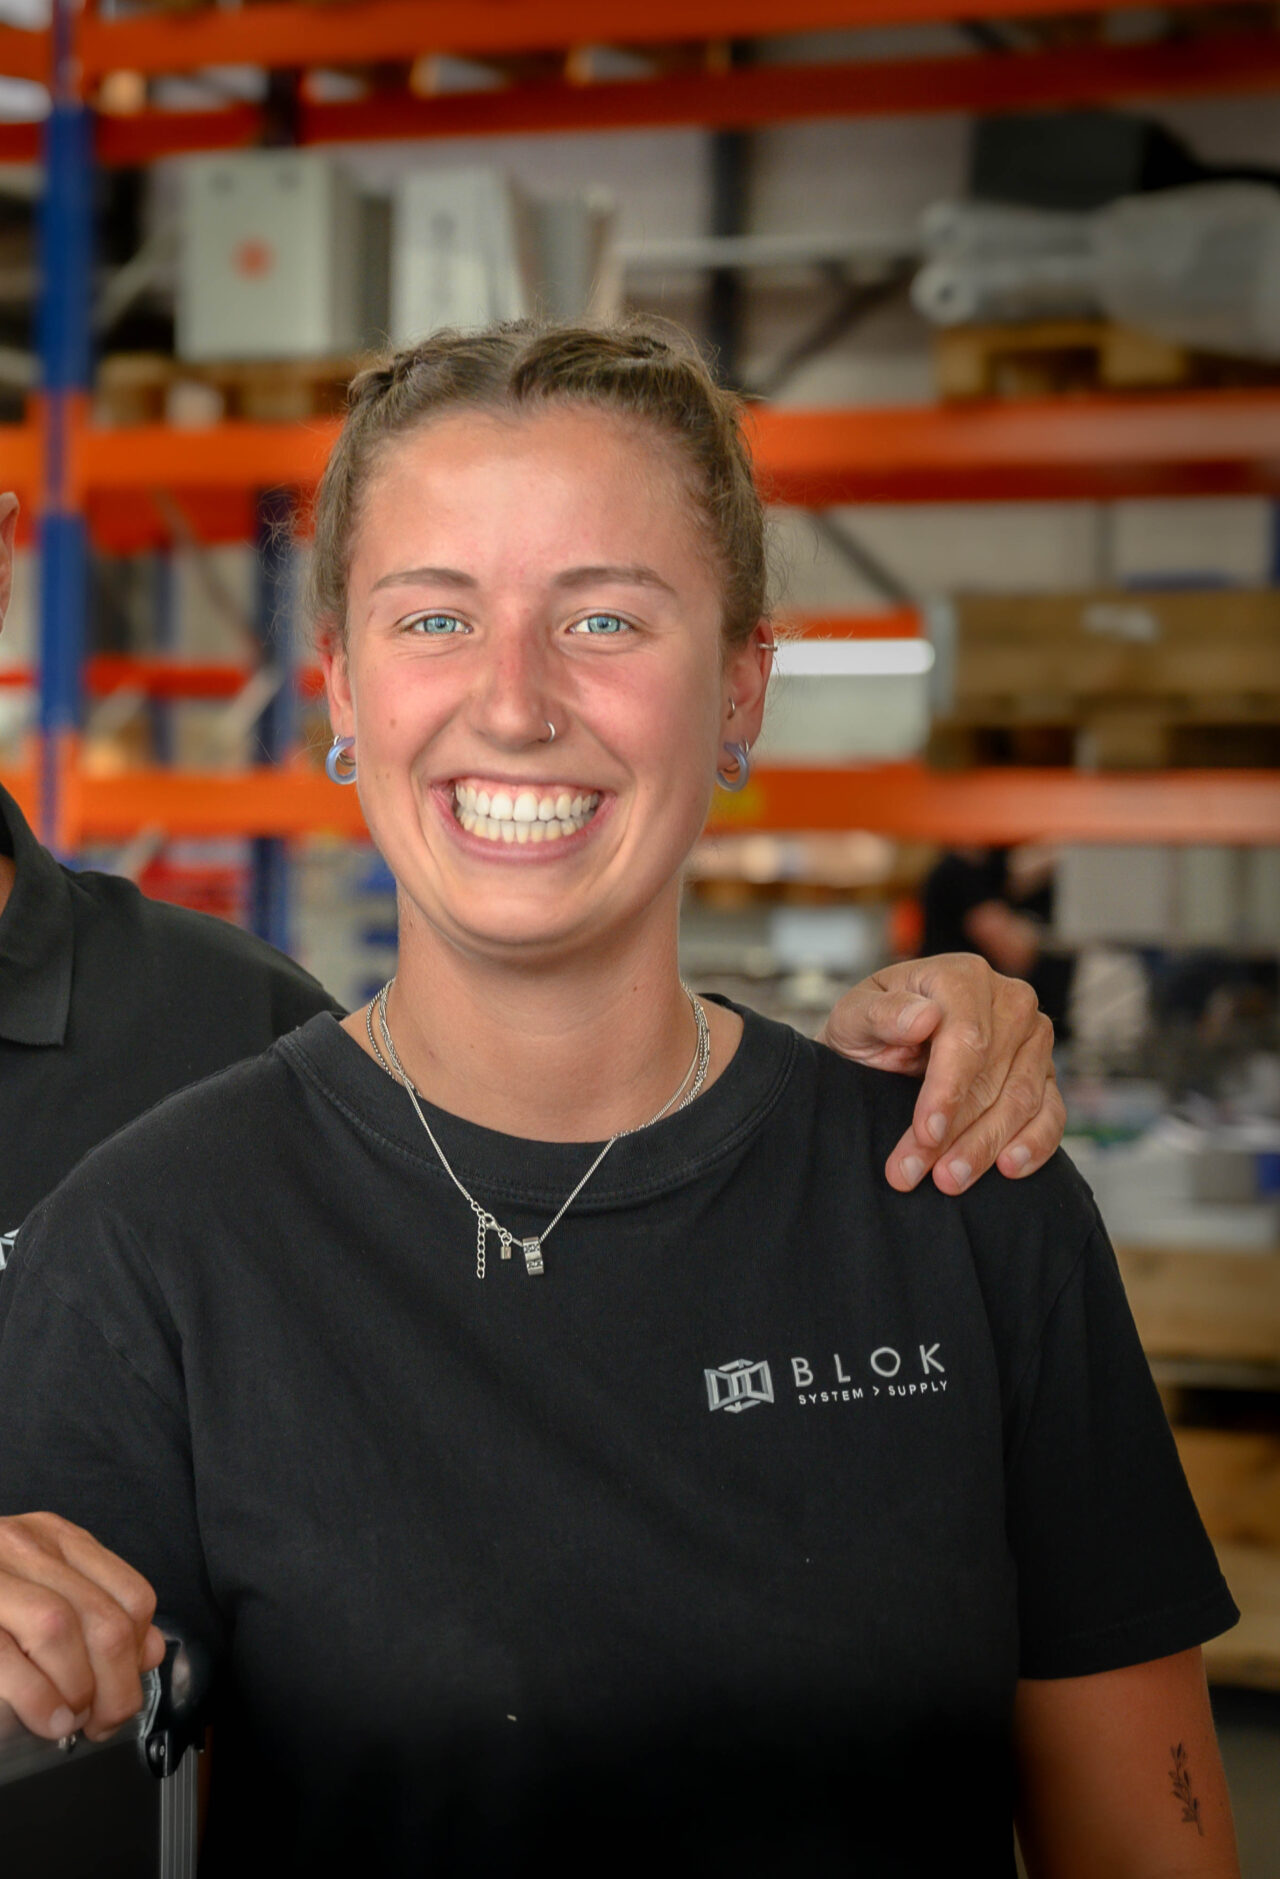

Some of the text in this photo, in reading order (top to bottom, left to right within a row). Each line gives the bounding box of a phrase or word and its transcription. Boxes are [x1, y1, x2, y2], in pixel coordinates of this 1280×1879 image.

[790, 1343, 945, 1388] BLOK
[798, 1387, 864, 1405] SYSTEM
[888, 1380, 948, 1397] SUPPLY
